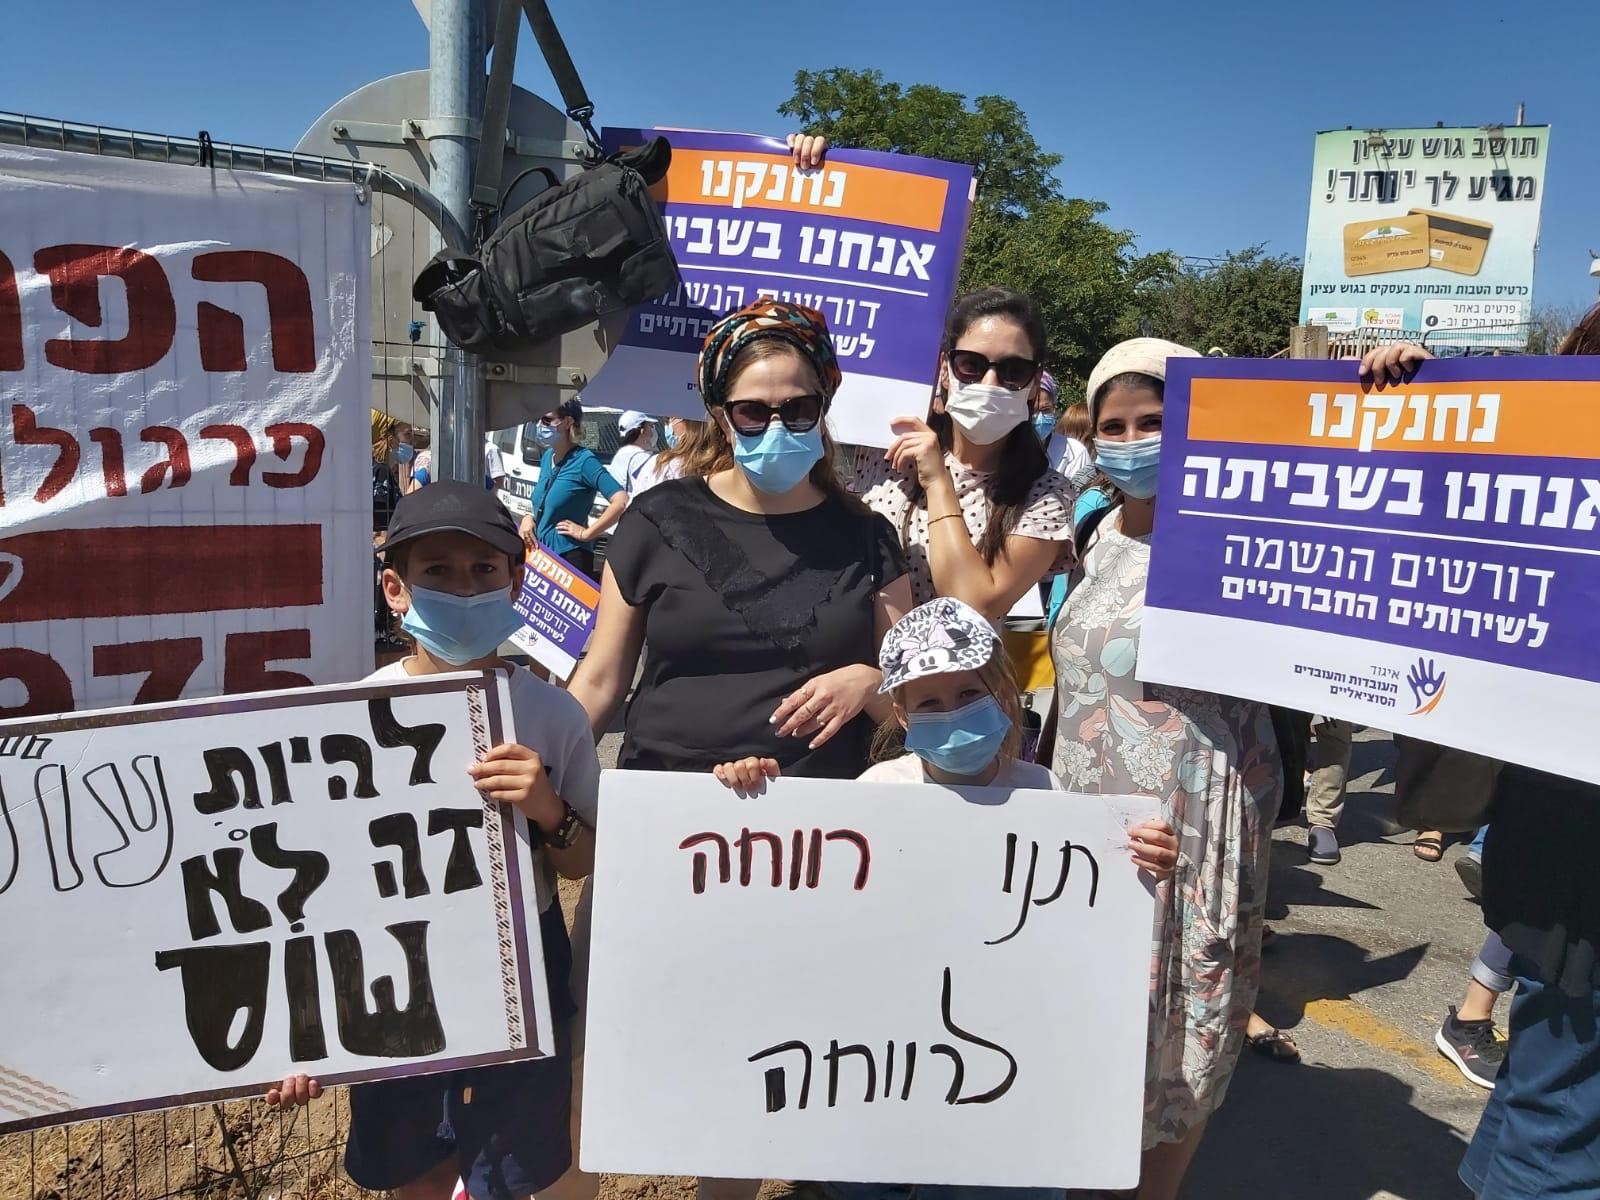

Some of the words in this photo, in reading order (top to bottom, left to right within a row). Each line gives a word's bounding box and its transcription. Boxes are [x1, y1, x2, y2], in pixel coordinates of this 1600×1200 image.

[1354, 137, 1413, 163] עצון
[1423, 136, 1463, 158] גוש
[1472, 136, 1537, 158] תושב
[700, 159, 846, 209] נחנקנו
[1327, 168, 1416, 202] יותר!
[1425, 170, 1460, 205] לך
[1469, 173, 1536, 200] מגיע
[799, 225, 936, 281] אנחנו
[1310, 284, 1336, 296] עציון
[1340, 283, 1366, 294] בגוש
[1370, 283, 1410, 296] בעסקים
[1415, 283, 1450, 294] והנחות
[1456, 284, 1490, 295] הטבות
[1496, 284, 1528, 295] כרטיס
[1453, 304, 1480, 314] באתר
[1484, 304, 1516, 314] פרטים
[1307, 392, 1501, 453] נחנקנו
[1182, 455, 1424, 516] בשביתה
[1224, 533, 1375, 583] הנשמה
[1390, 551, 1555, 607] דורשים
[1221, 576, 1377, 620] החברתיים
[1387, 598, 1550, 649] לשירותים
[1294, 664, 1346, 682] והעובדים
[1349, 675, 1398, 693] העובדות
[1370, 665, 1400, 680] איגוד
[1330, 685, 1396, 707] הסוציאליים
[193, 697, 447, 815] להיות
[678, 826, 871, 894] רווחה
[984, 832, 1099, 945] תנו
[747, 966, 1018, 1113] לרווחה
